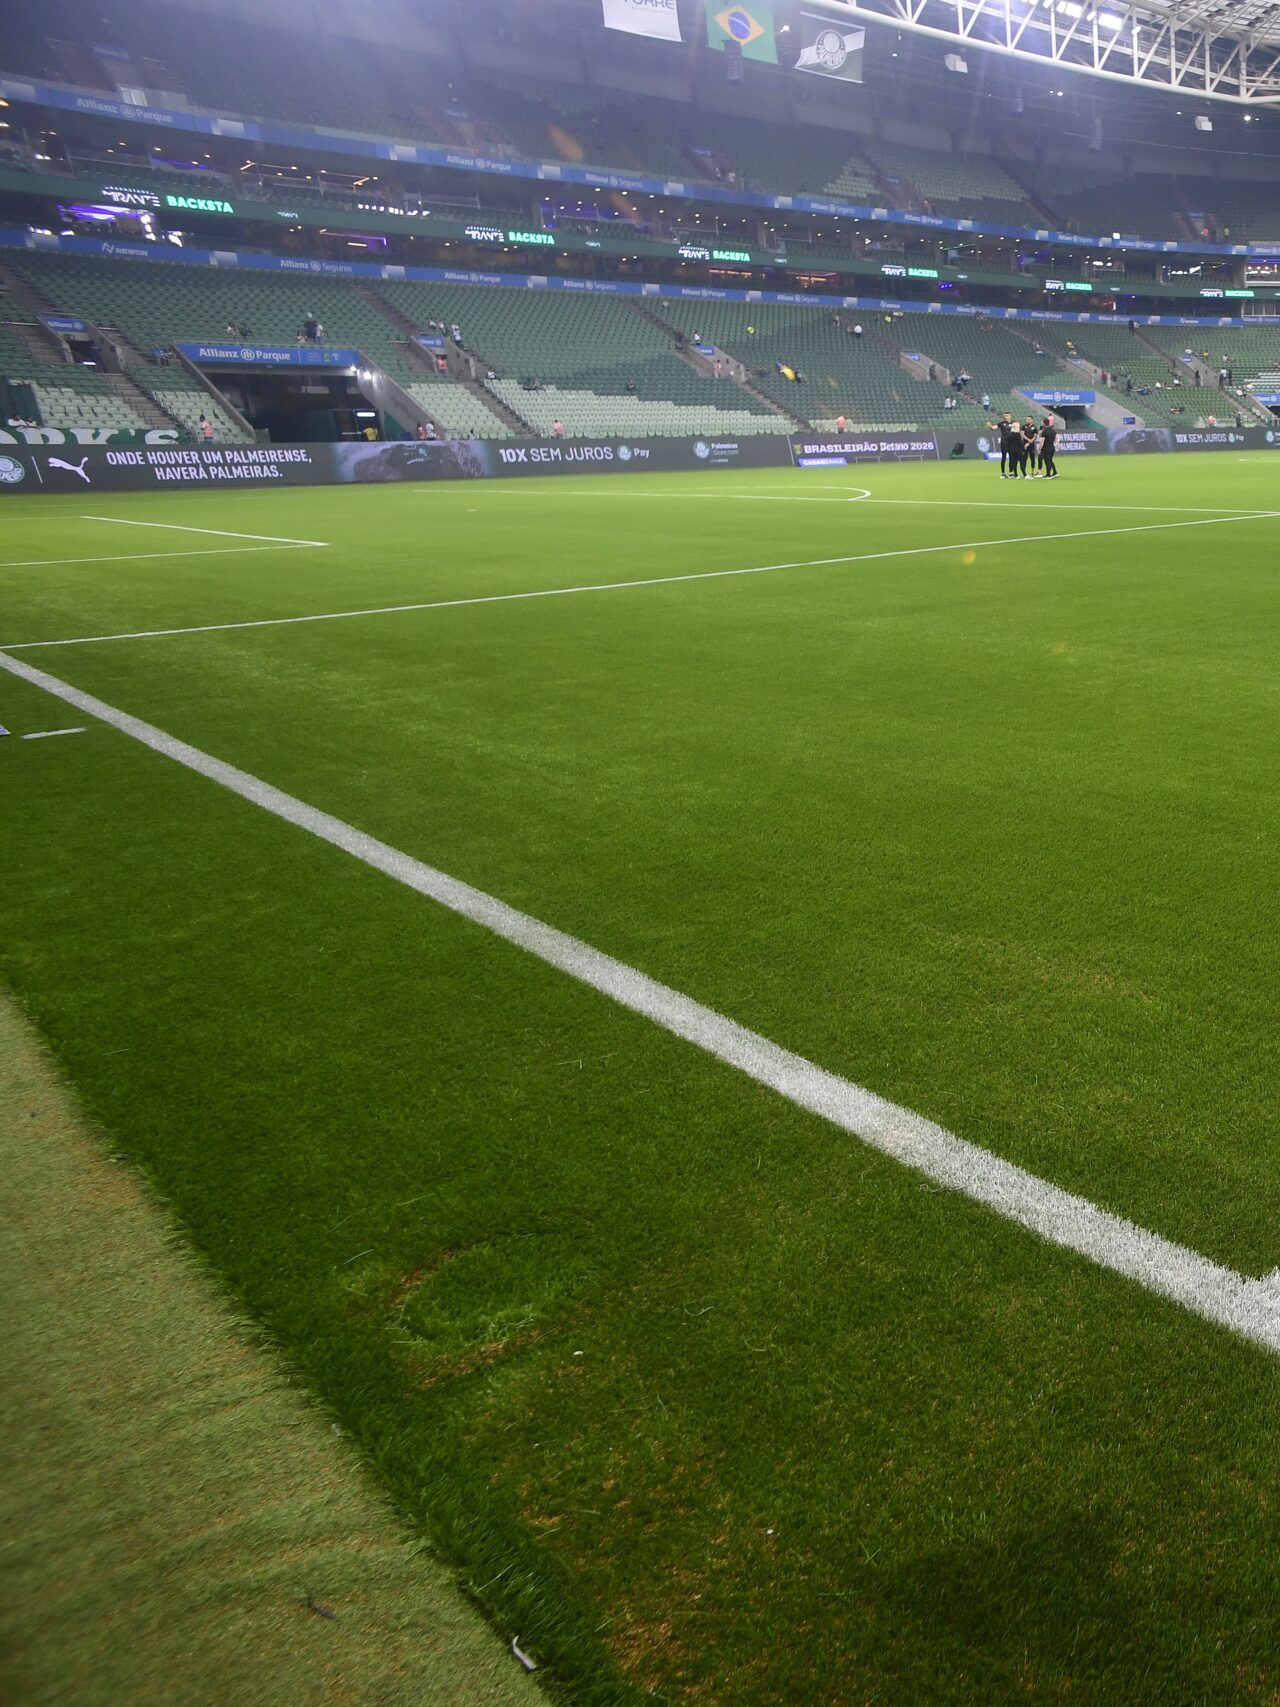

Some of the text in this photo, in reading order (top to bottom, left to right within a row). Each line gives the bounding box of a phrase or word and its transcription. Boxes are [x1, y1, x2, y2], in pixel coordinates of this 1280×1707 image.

[77, 98, 173, 123] Allianz Parque
[447, 154, 511, 172] Allianz Parque
[585, 174, 643, 189] Allianz Seguros
[166, 195, 234, 213] BACKSTA
[810, 202, 828, 210] Allianz
[508, 232, 555, 245] BACKSTA
[115, 247, 148, 257] NEWON
[713, 250, 750, 262] BACKSTA
[280, 260, 352, 272] Allianz Seguros
[444, 272, 500, 283] Allianz Parque
[908, 268, 938, 278] BACKSTA
[564, 280, 616, 292] Allianz Seguros
[199, 348, 291, 361] Allianz Parque
[1062, 393, 1080, 402] Parque
[1175, 433, 1227, 443] 10X SEM JUROS
[500, 446, 614, 462] 10X SEM JUROS
[634, 447, 650, 458] Pay
[804, 442, 934, 454] BRASILEIRÃO Betano 2026
[106, 449, 312, 465] ONDE HOUVER UM PALMEIRENSE,
[154, 463, 284, 480] HAVERÁ PALMEIRAS.
